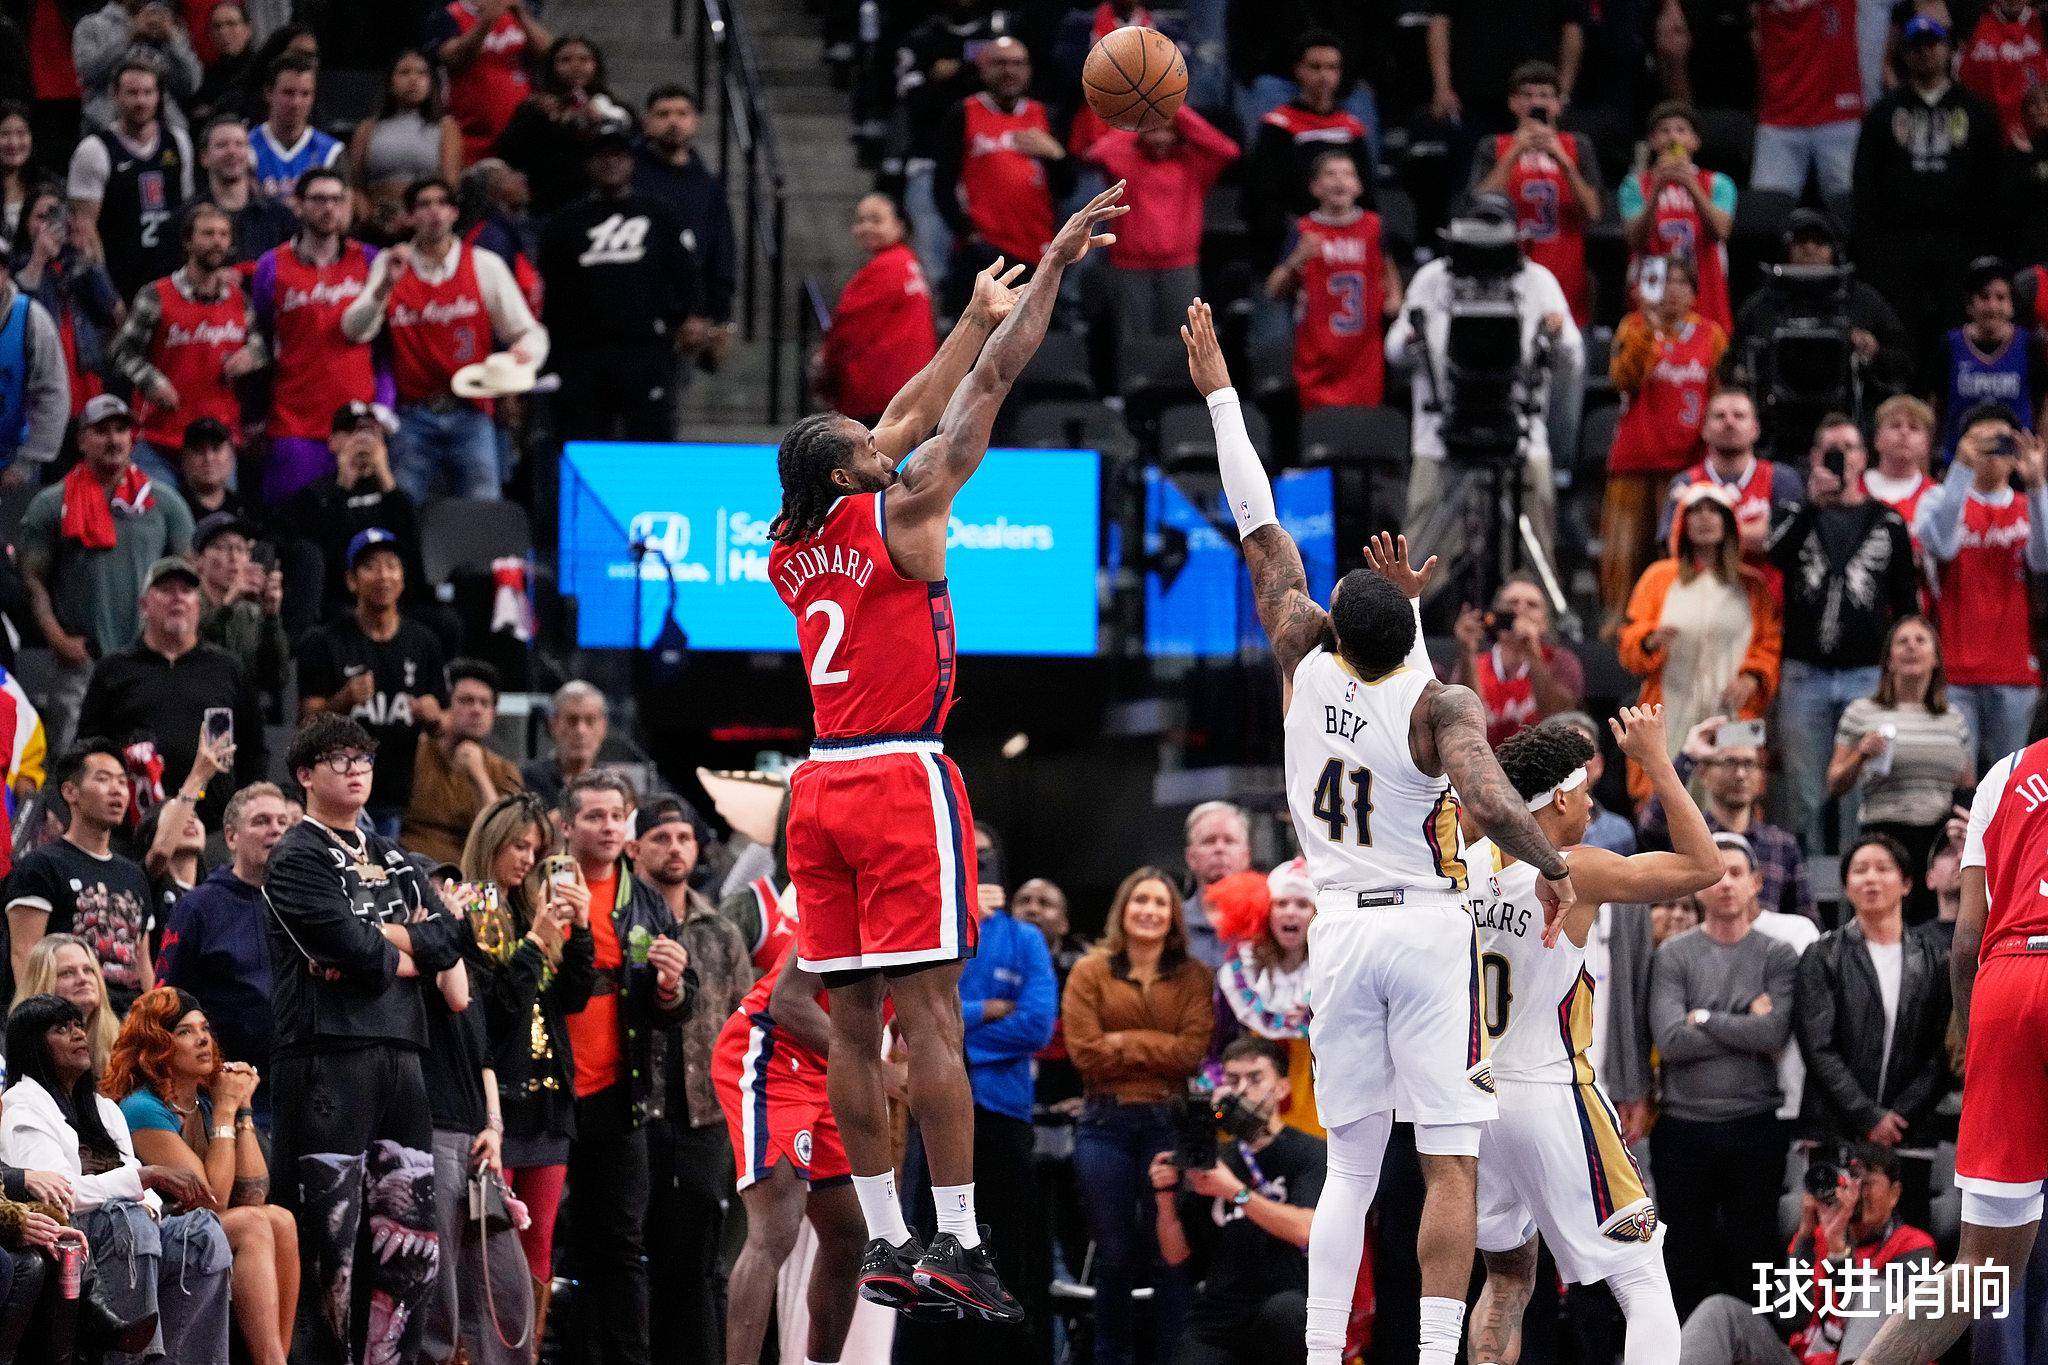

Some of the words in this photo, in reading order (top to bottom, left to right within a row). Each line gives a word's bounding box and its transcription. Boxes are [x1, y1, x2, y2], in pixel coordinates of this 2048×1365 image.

[1327, 270, 1366, 337] 3
[779, 544, 874, 598] LEONARD
[806, 599, 850, 686] 2
[1324, 705, 1368, 743] BEY
[1312, 757, 1375, 848] 41
[2015, 767, 2048, 813] JO
[1469, 899, 1532, 938] EARS
